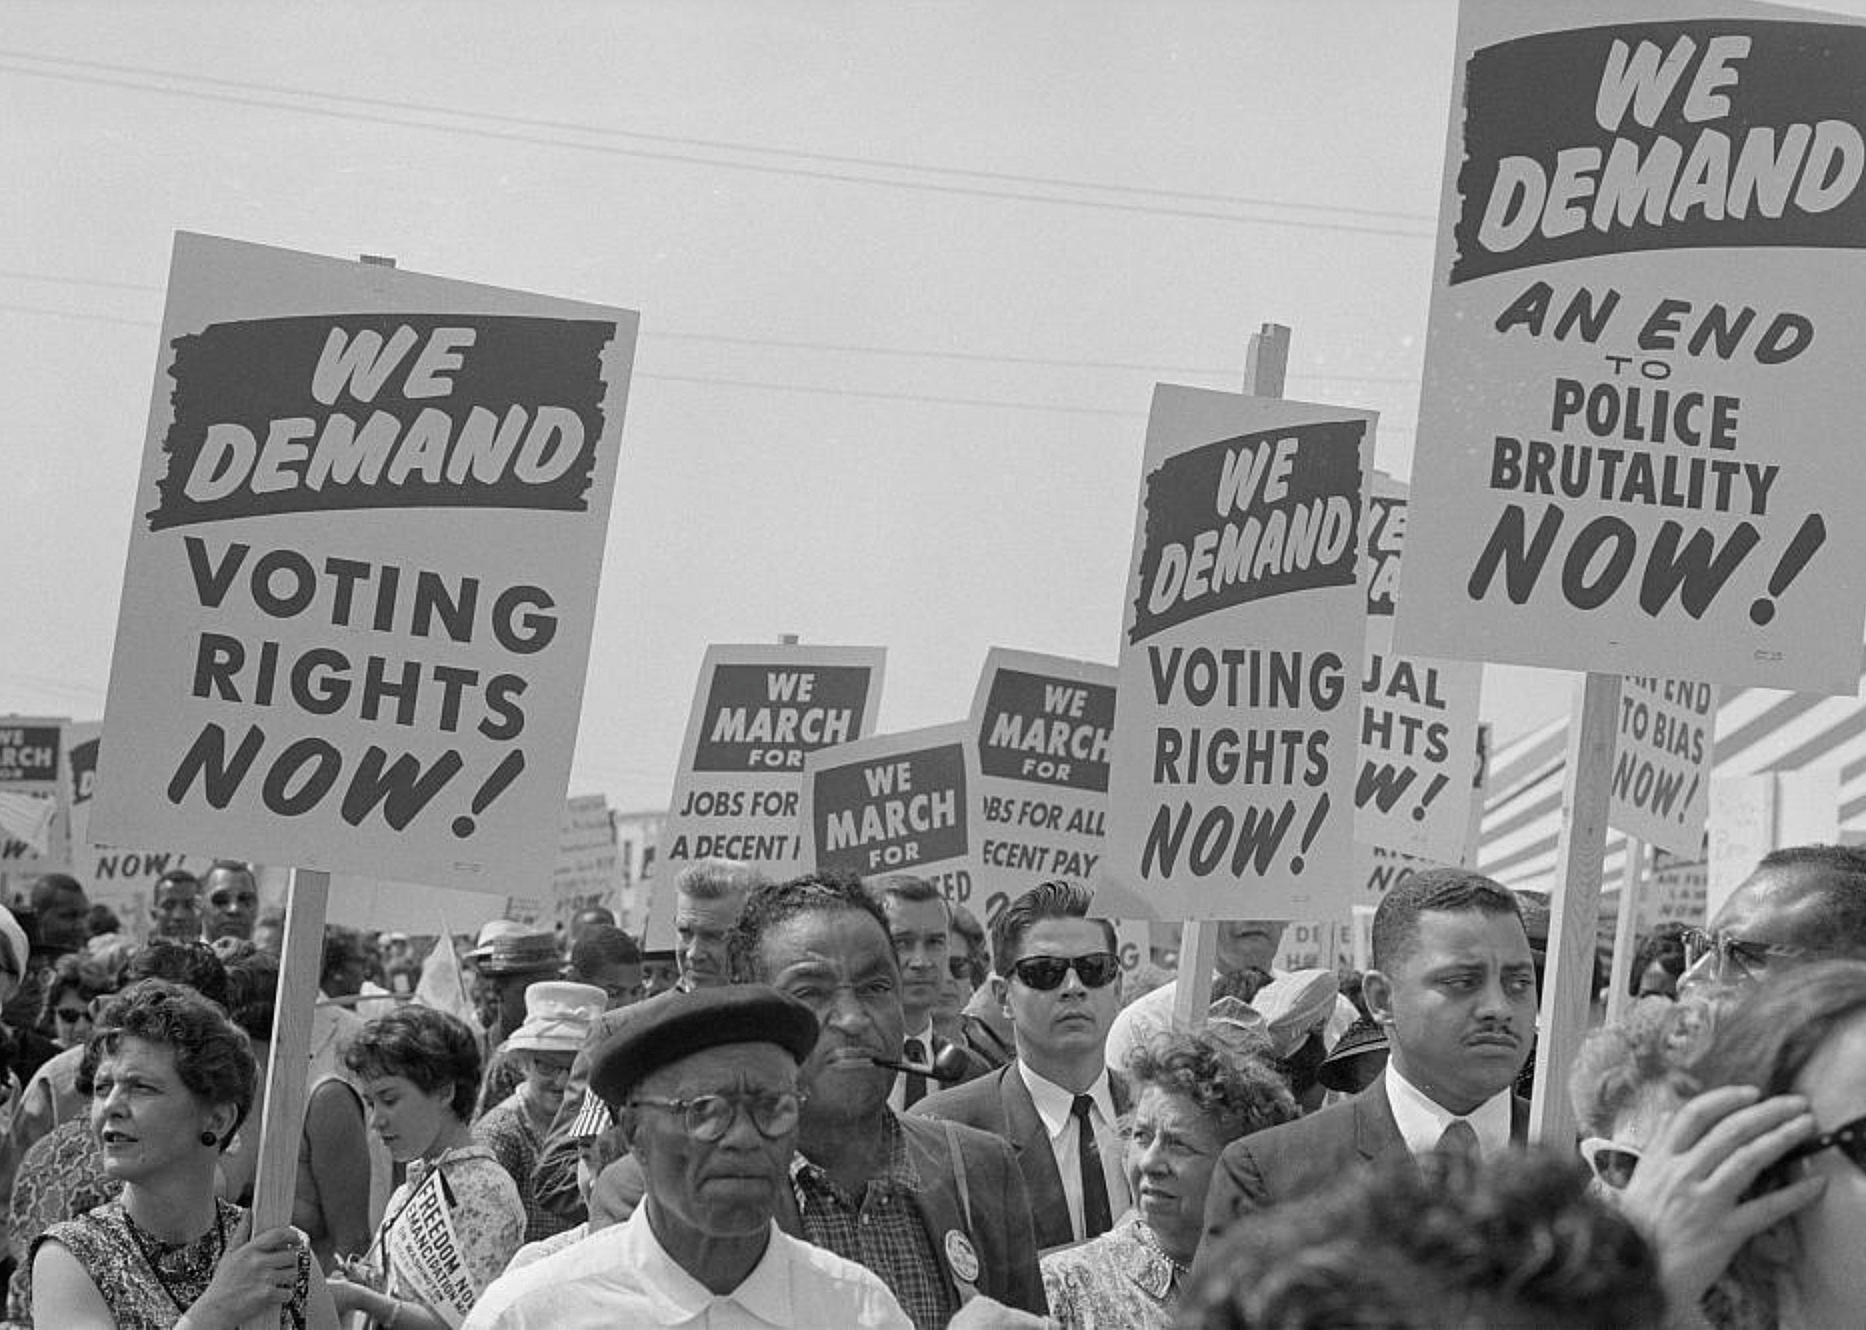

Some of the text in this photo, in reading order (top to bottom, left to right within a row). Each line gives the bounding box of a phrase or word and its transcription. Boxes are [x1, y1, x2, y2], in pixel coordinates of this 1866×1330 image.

[1595, 34, 1753, 132] WE
[1477, 119, 1864, 253] DEMAND
[1494, 280, 1814, 365] AN END
[311, 323, 477, 405] WE
[1604, 354, 1671, 380] TO
[1551, 377, 1741, 451] POLICE
[183, 403, 585, 502] DEMAND
[1217, 437, 1299, 517] WE
[1489, 435, 1779, 516] BRUTALITY
[1148, 495, 1353, 615] DEMAND
[1467, 502, 1826, 626] NOW!
[184, 535, 558, 655] VOTING
[192, 631, 529, 741] RIGHTS
[767, 672, 815, 702] WE
[1045, 684, 1089, 718] WE
[1148, 645, 1345, 712] VOTING
[1664, 679, 1711, 715] END
[710, 707, 852, 744] MARCH
[747, 749, 804, 767] FOR
[989, 712, 1113, 763] MARCH
[1154, 727, 1330, 787] RIGHTS
[1362, 706, 1449, 763] HTS
[1622, 696, 1704, 765] TO BIAS
[167, 721, 526, 838] NOW!
[864, 761, 911, 797] WE
[1021, 758, 1072, 781] FOR
[1354, 760, 1450, 822] W!
[1611, 750, 1699, 824] NOW!
[680, 791, 799, 817] JOBS FOR
[826, 789, 955, 851] MARCH
[984, 795, 1106, 837] BS FOR ALL
[1141, 791, 1330, 879] NOW!
[668, 835, 689, 860] A
[694, 835, 789, 860] DECENT
[869, 841, 920, 869] FOR
[1051, 849, 1099, 878] PAY
[405, 1202, 459, 1301] EMANCIPATION
[417, 1180, 461, 1276] FREEDOM
